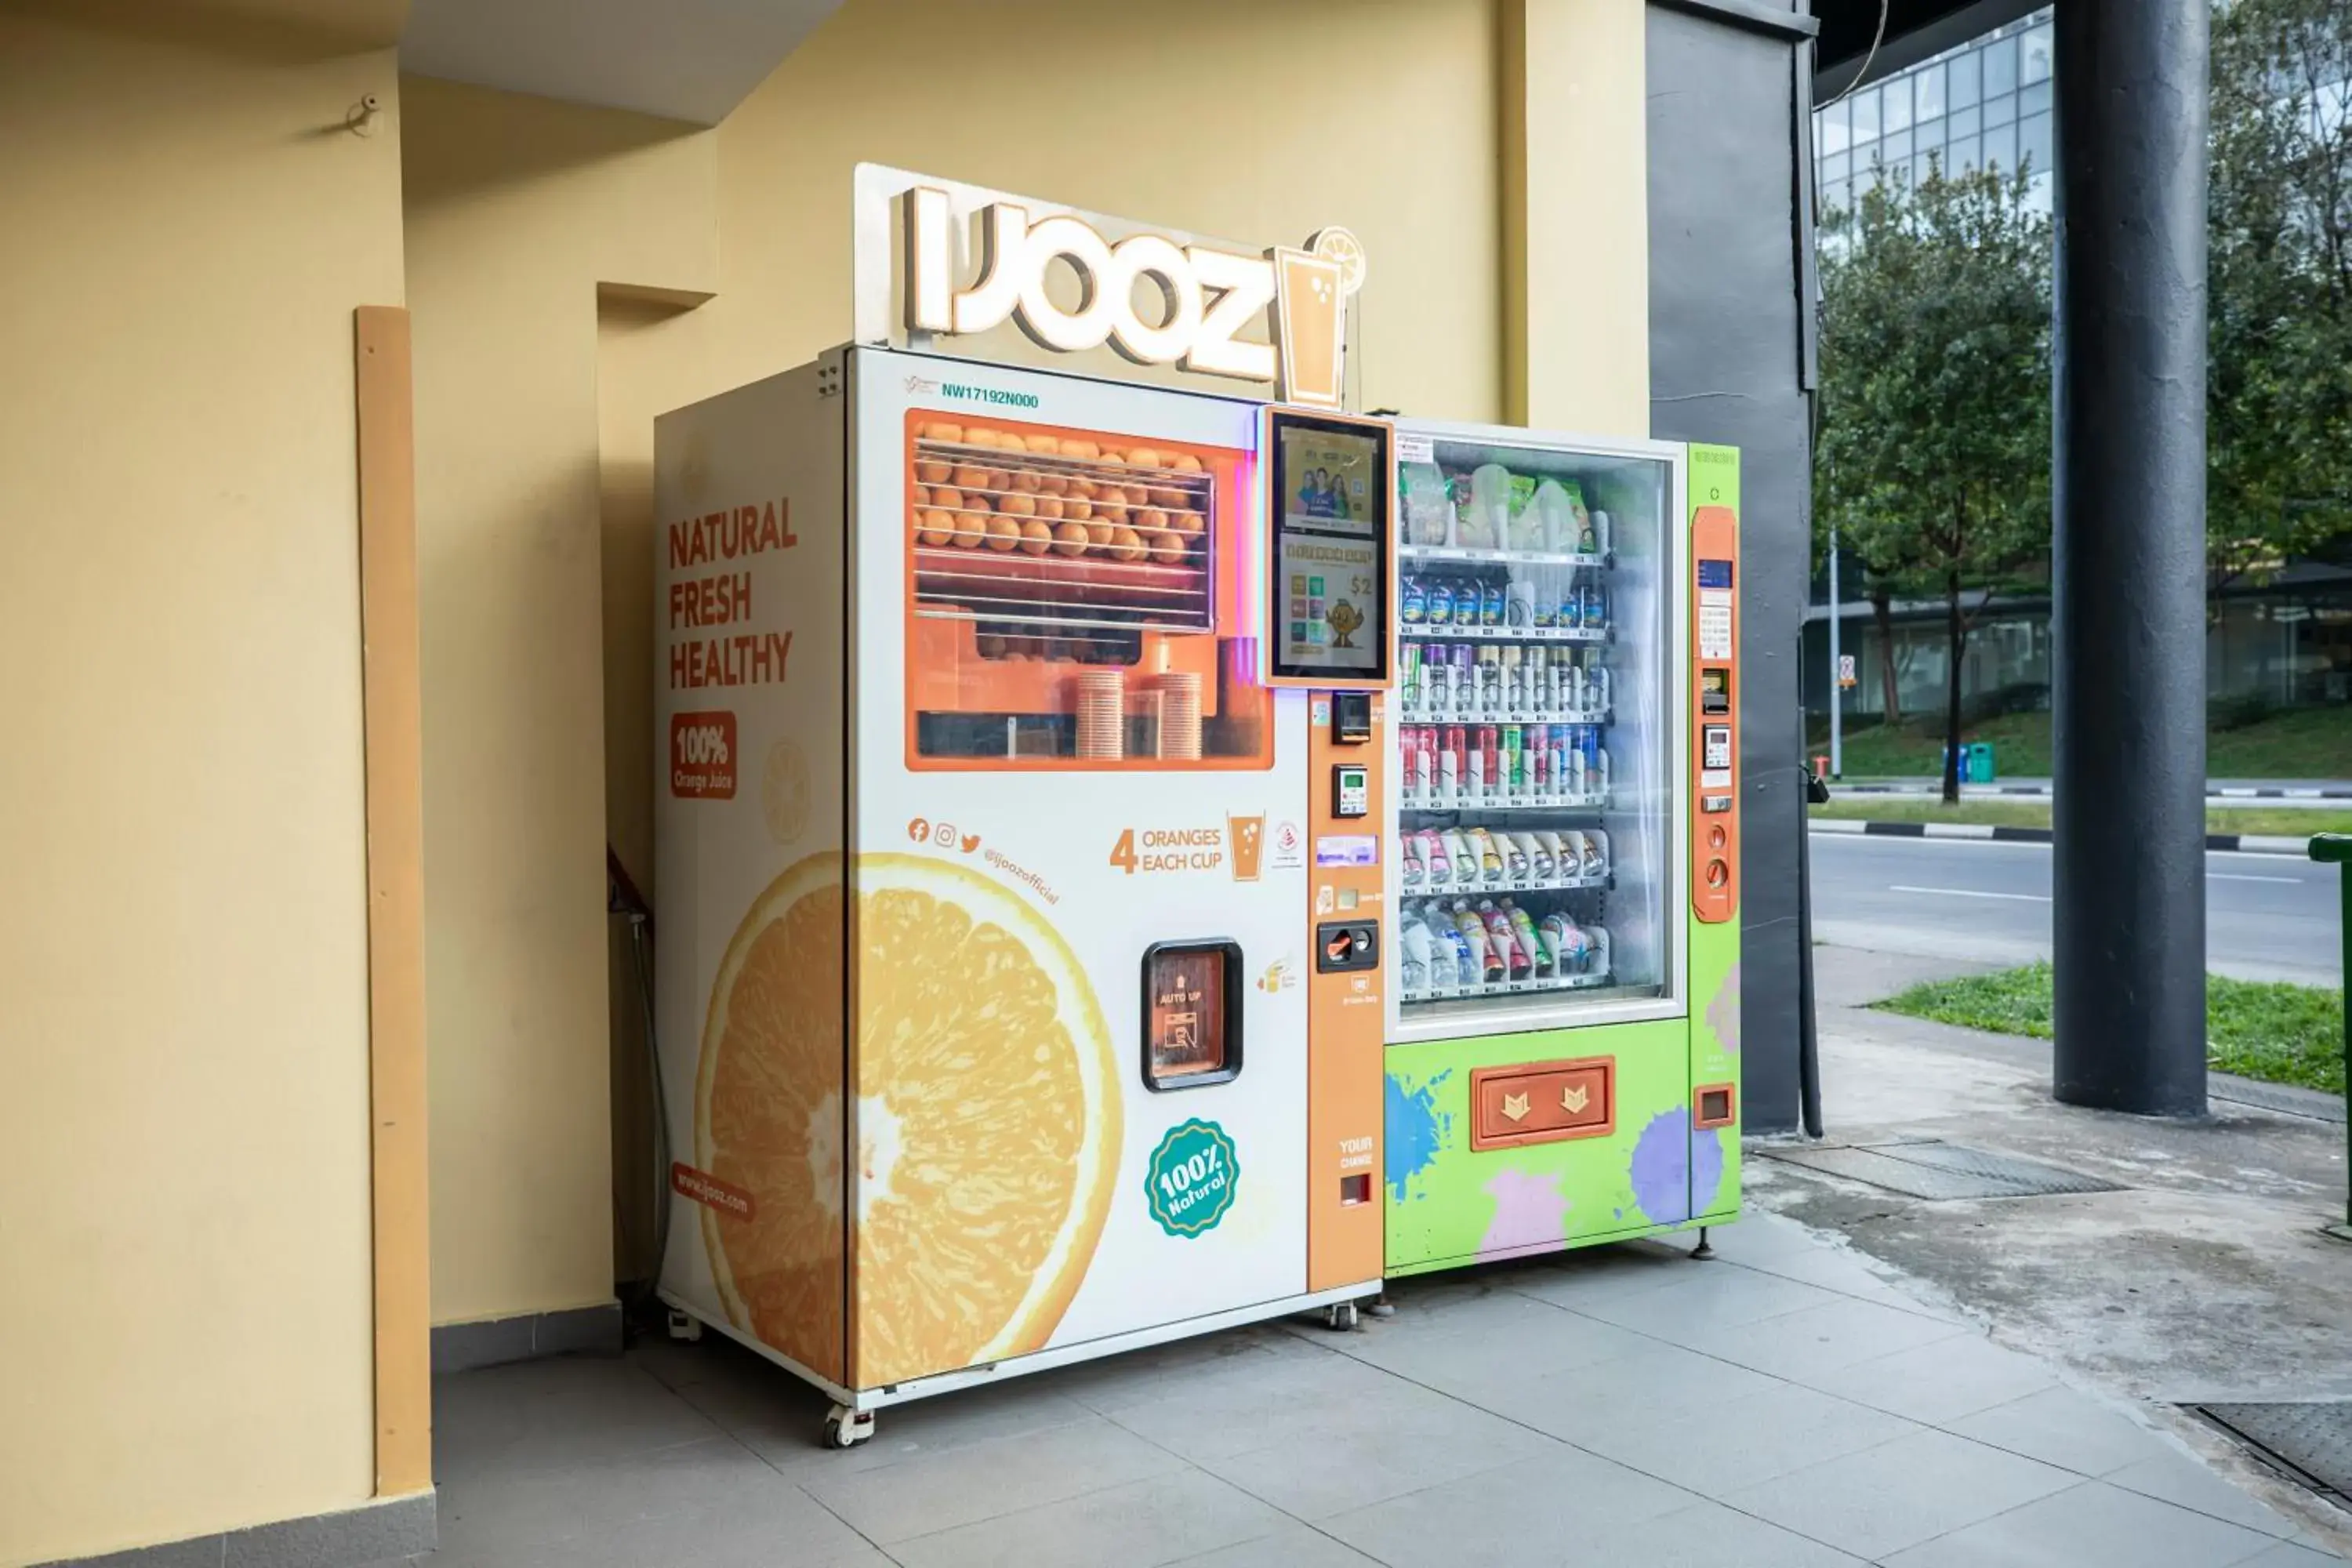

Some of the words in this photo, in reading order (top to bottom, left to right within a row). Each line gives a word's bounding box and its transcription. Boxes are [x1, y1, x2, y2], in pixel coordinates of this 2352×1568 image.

[908, 187, 1277, 382] IJOOZ
[942, 383, 1039, 409] NW17192N000
[670, 497, 797, 570] NATURAL
[670, 571, 751, 630] FRESH
[1351, 574, 1372, 596] $2
[670, 630, 793, 689] HEALTHY
[677, 724, 728, 765] 100%
[674, 771, 707, 793] Orange
[708, 770, 732, 789] Juice
[1109, 828, 1138, 875] 4
[1142, 829, 1221, 848] ORANGES
[983, 848, 1060, 906] @ijoozofficial
[1142, 854, 1187, 871] EACH
[1190, 852, 1222, 869] CUP
[1160, 992, 1186, 1005] AUTO
[1188, 991, 1202, 1004] UP
[1339, 1136, 1374, 1154] YOUR
[1340, 1154, 1373, 1169] CHANGE
[1160, 1144, 1222, 1199] 100%
[677, 1173, 748, 1214] www.ijooz.com
[1168, 1171, 1226, 1218] Natural
